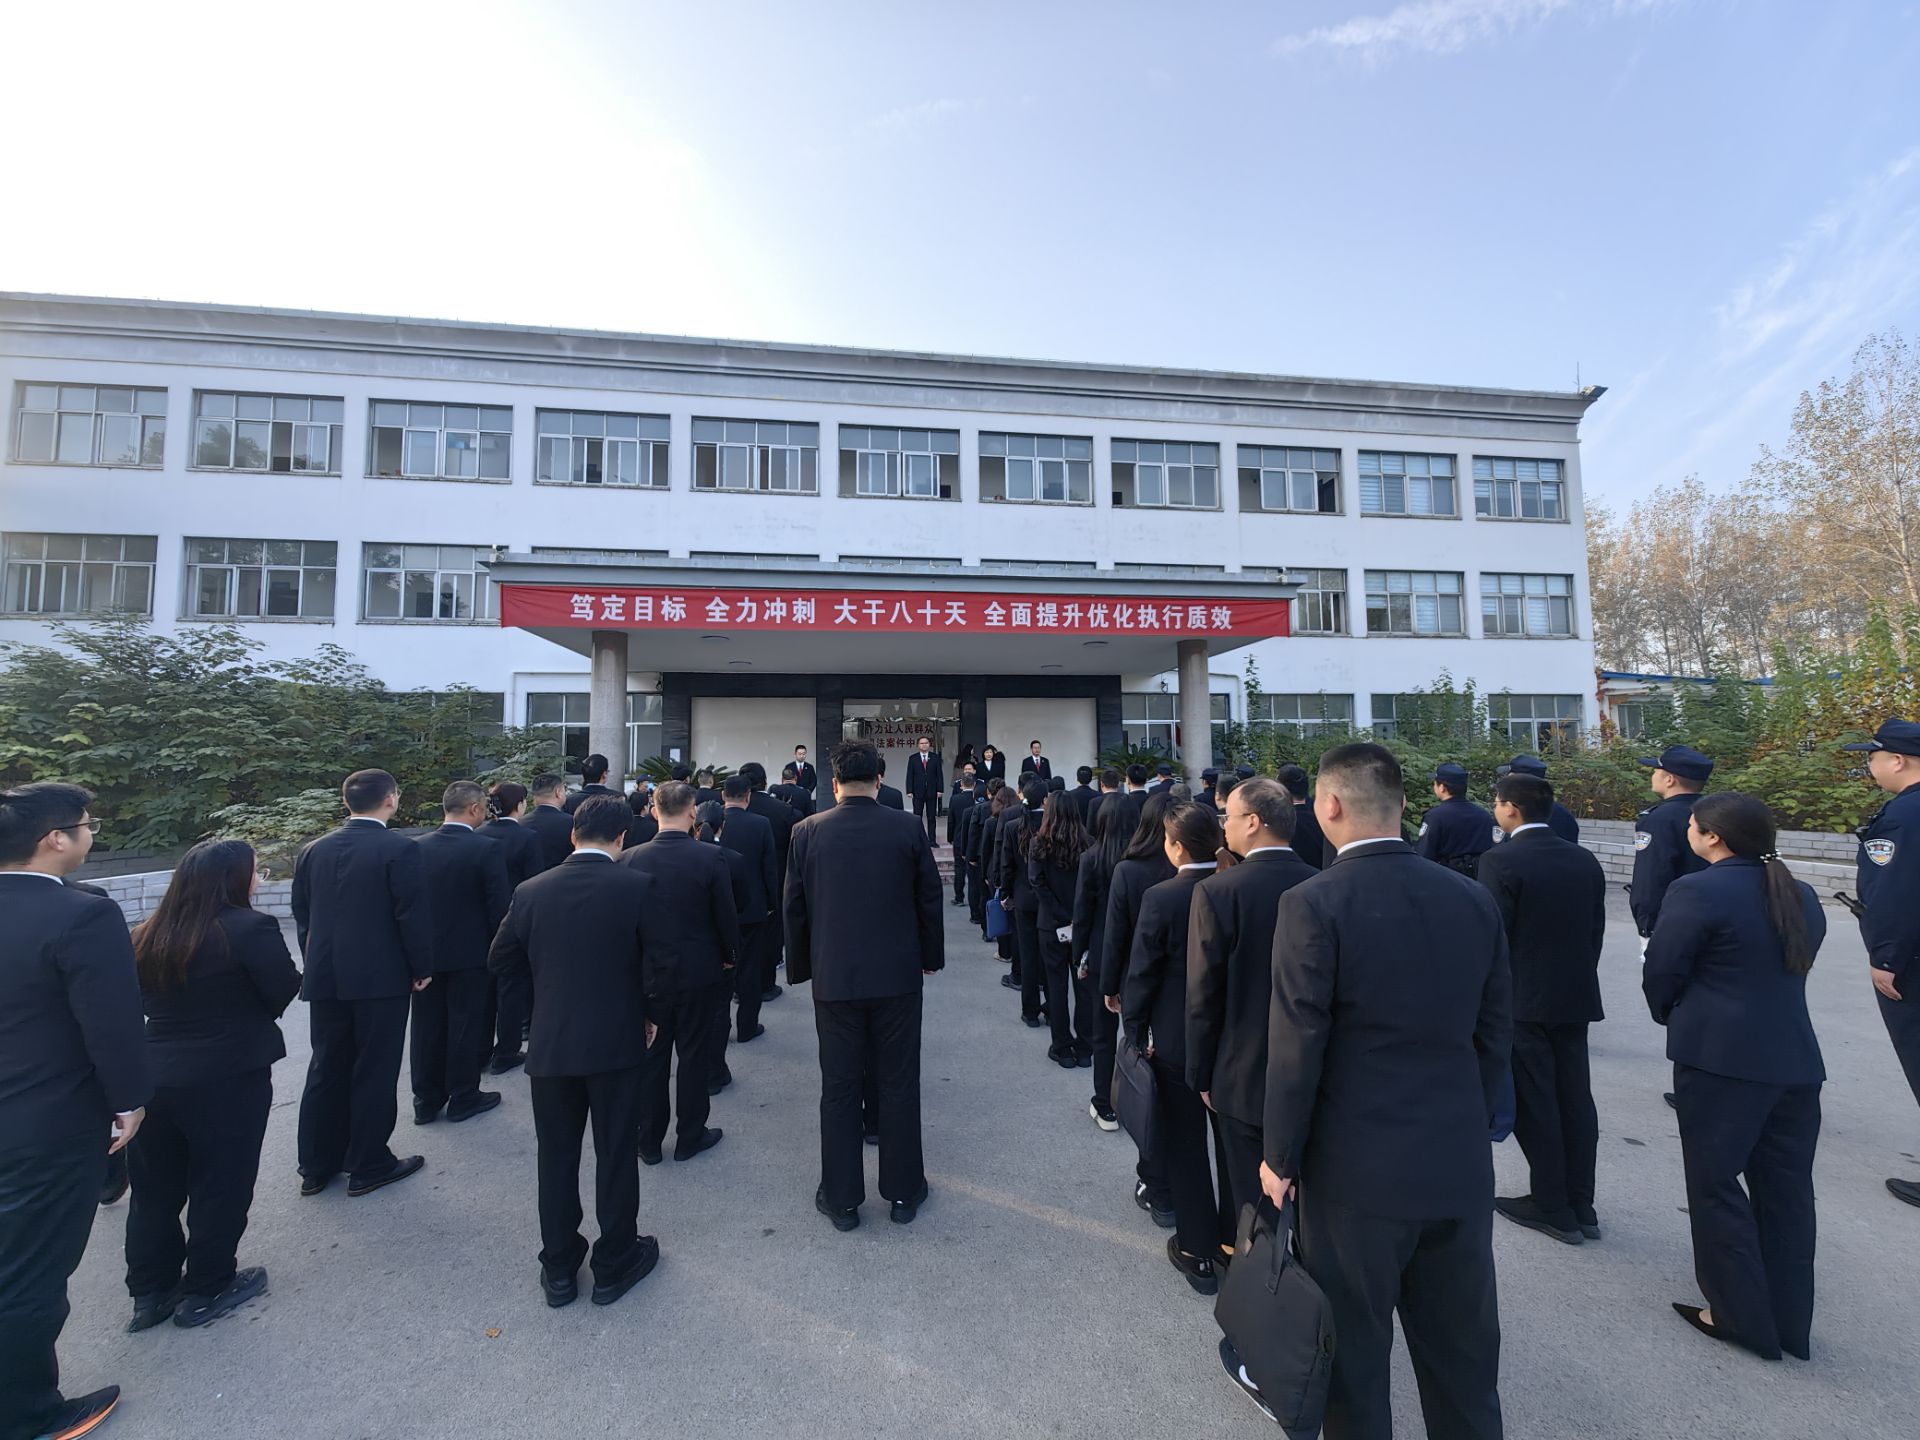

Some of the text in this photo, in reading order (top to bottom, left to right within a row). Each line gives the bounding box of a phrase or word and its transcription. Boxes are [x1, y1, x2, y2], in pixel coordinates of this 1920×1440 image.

[570, 593, 1232, 630] 笃定目标 全力冲刺 大干八十天 全面提升优化执行质效
